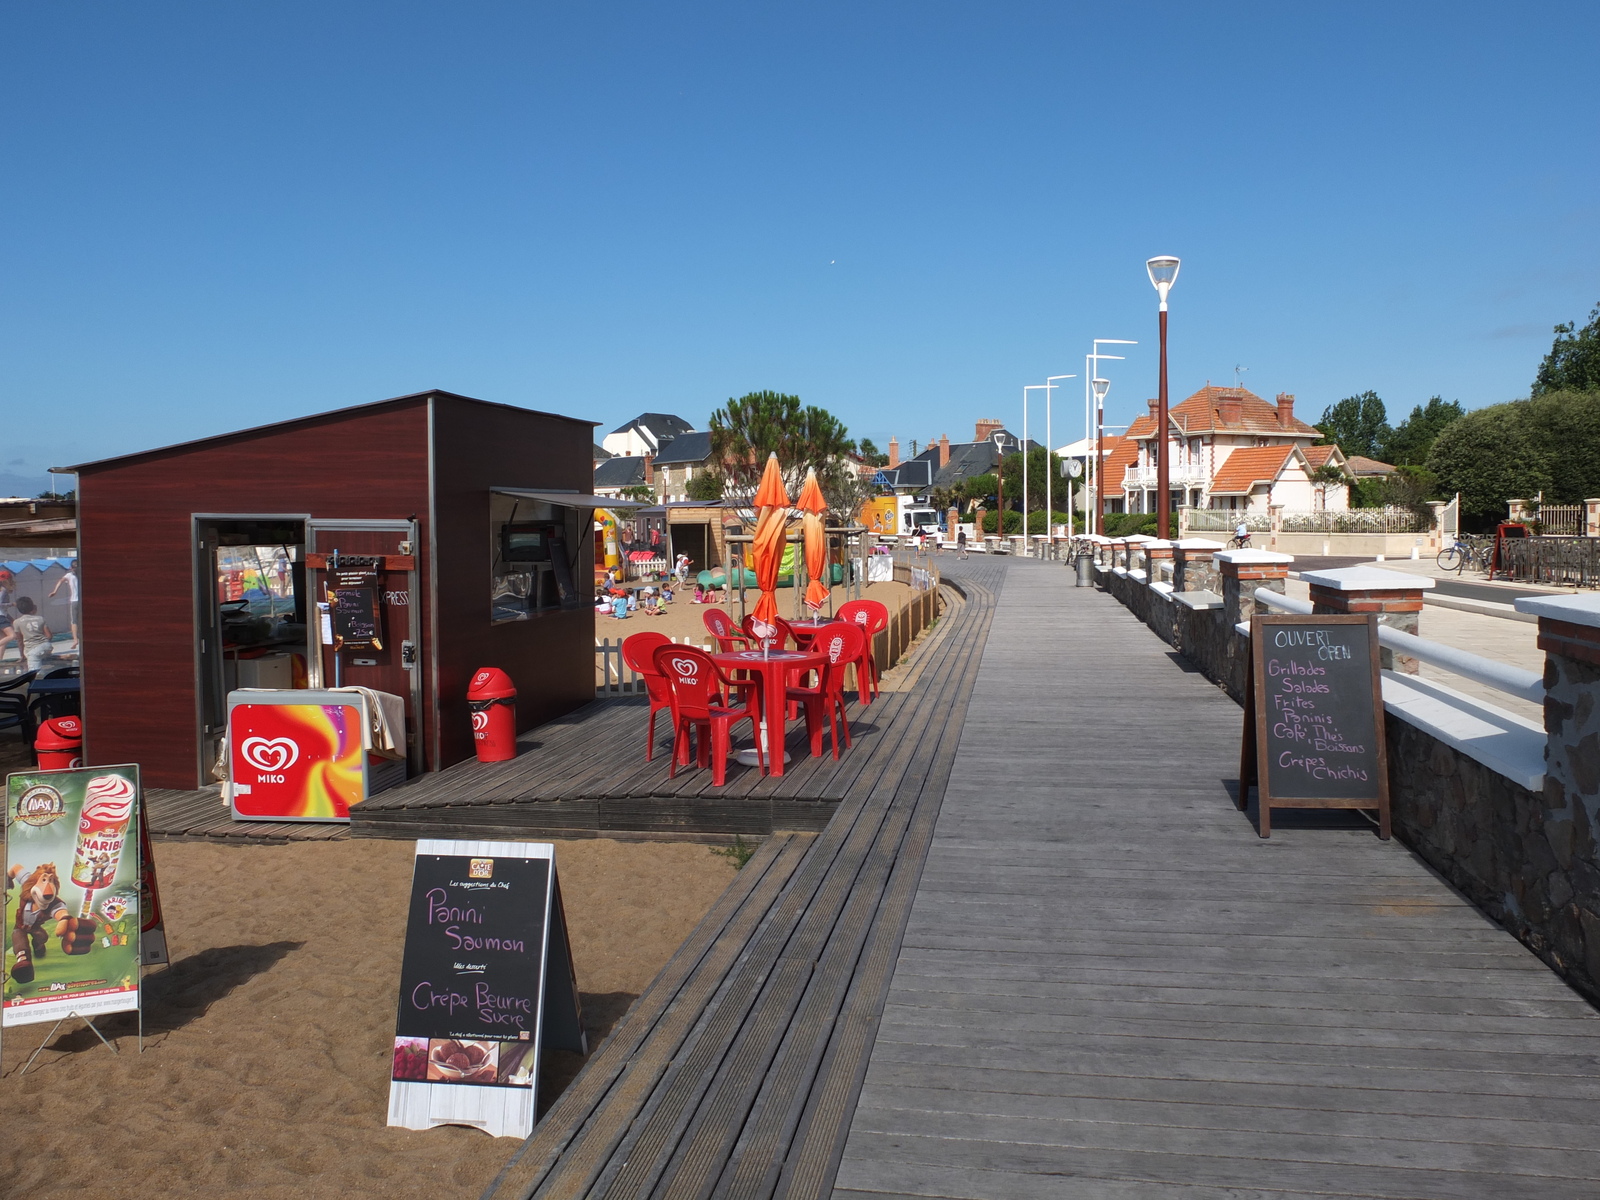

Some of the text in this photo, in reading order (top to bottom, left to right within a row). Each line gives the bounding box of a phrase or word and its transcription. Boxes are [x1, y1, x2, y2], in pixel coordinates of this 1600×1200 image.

[1275, 630, 1334, 648] OUVERT
[1318, 645, 1351, 660] OPEN
[1268, 659, 1326, 677] Grillades
[679, 677, 697, 685] MIKO
[1282, 678, 1330, 694] Salades
[1274, 694, 1316, 710] Frites
[258, 774, 285, 783] MIKO
[102, 897, 127, 908] HARIBO
[426, 888, 486, 924] Panini
[445, 926, 524, 952] Saumon
[475, 981, 530, 1013] Beurre
[479, 1008, 524, 1030] Sucre
